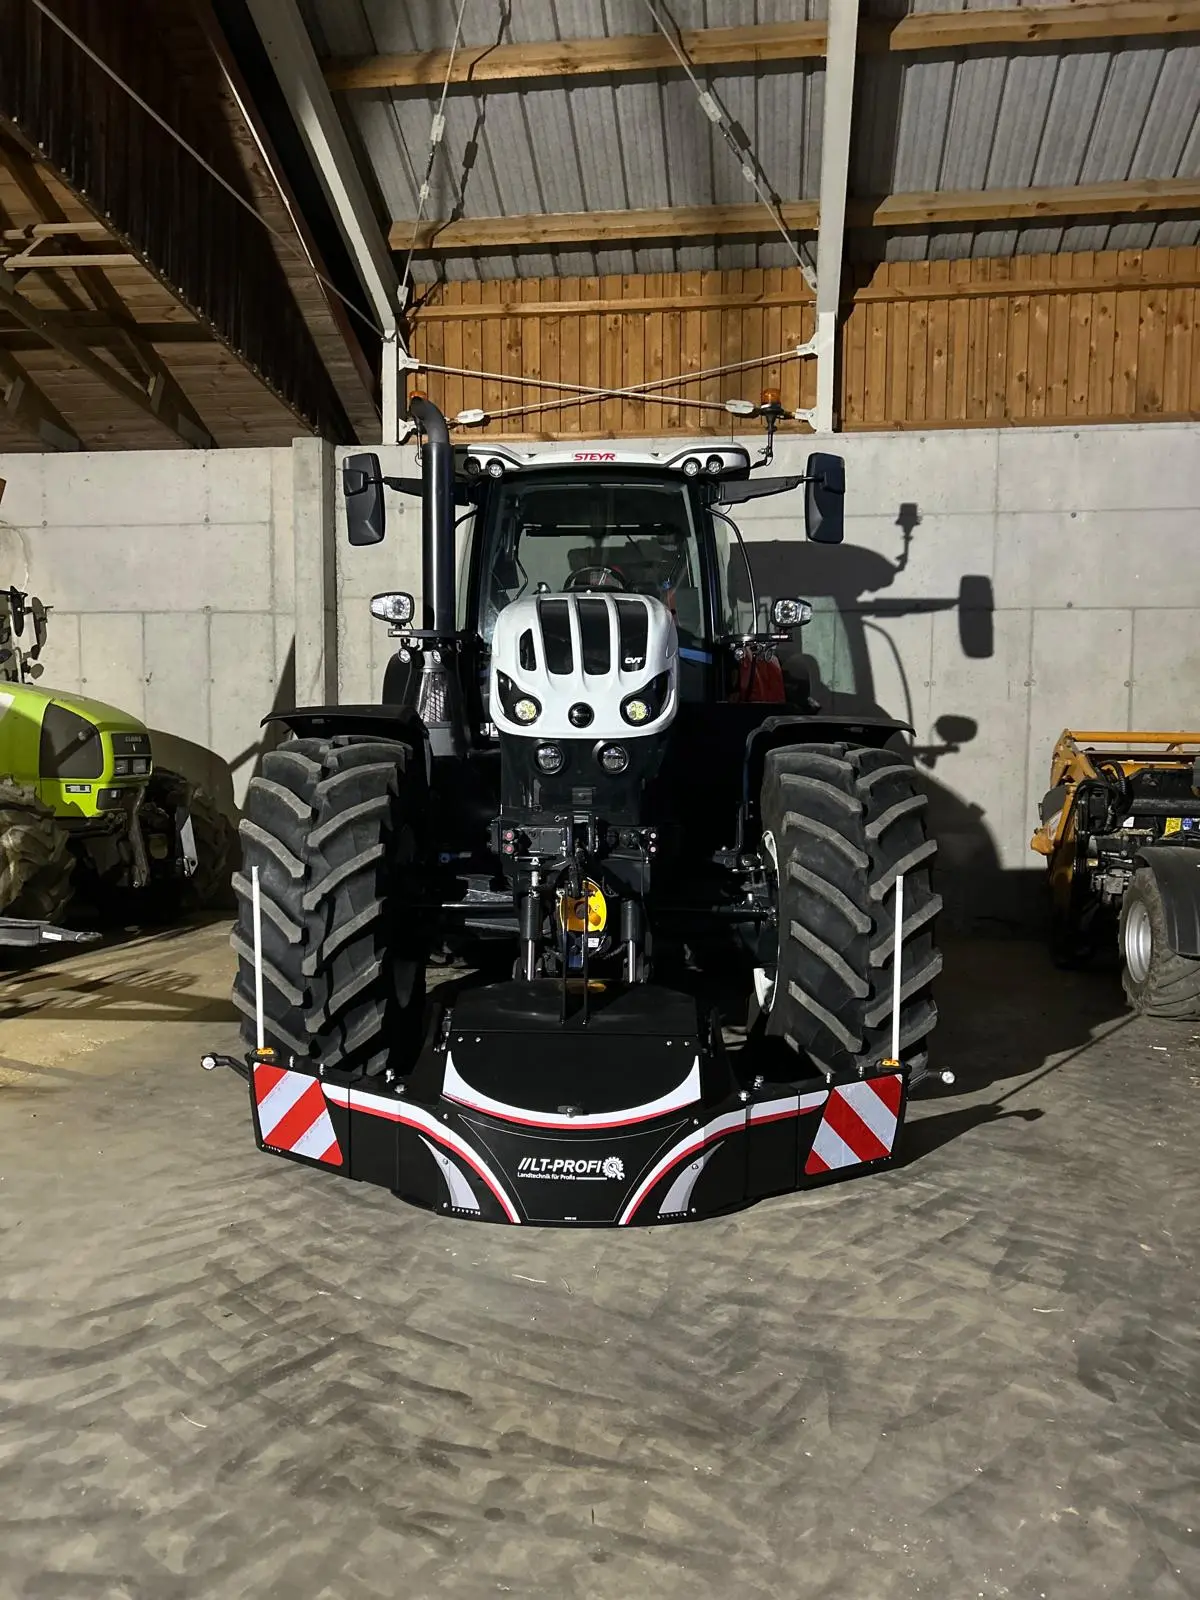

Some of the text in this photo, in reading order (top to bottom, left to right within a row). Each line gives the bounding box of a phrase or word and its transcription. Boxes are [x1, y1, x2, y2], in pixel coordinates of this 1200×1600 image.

[573, 452, 616, 461] STEYR
[624, 656, 643, 664] CVT
[517, 1171, 550, 1179] Landtechnik
